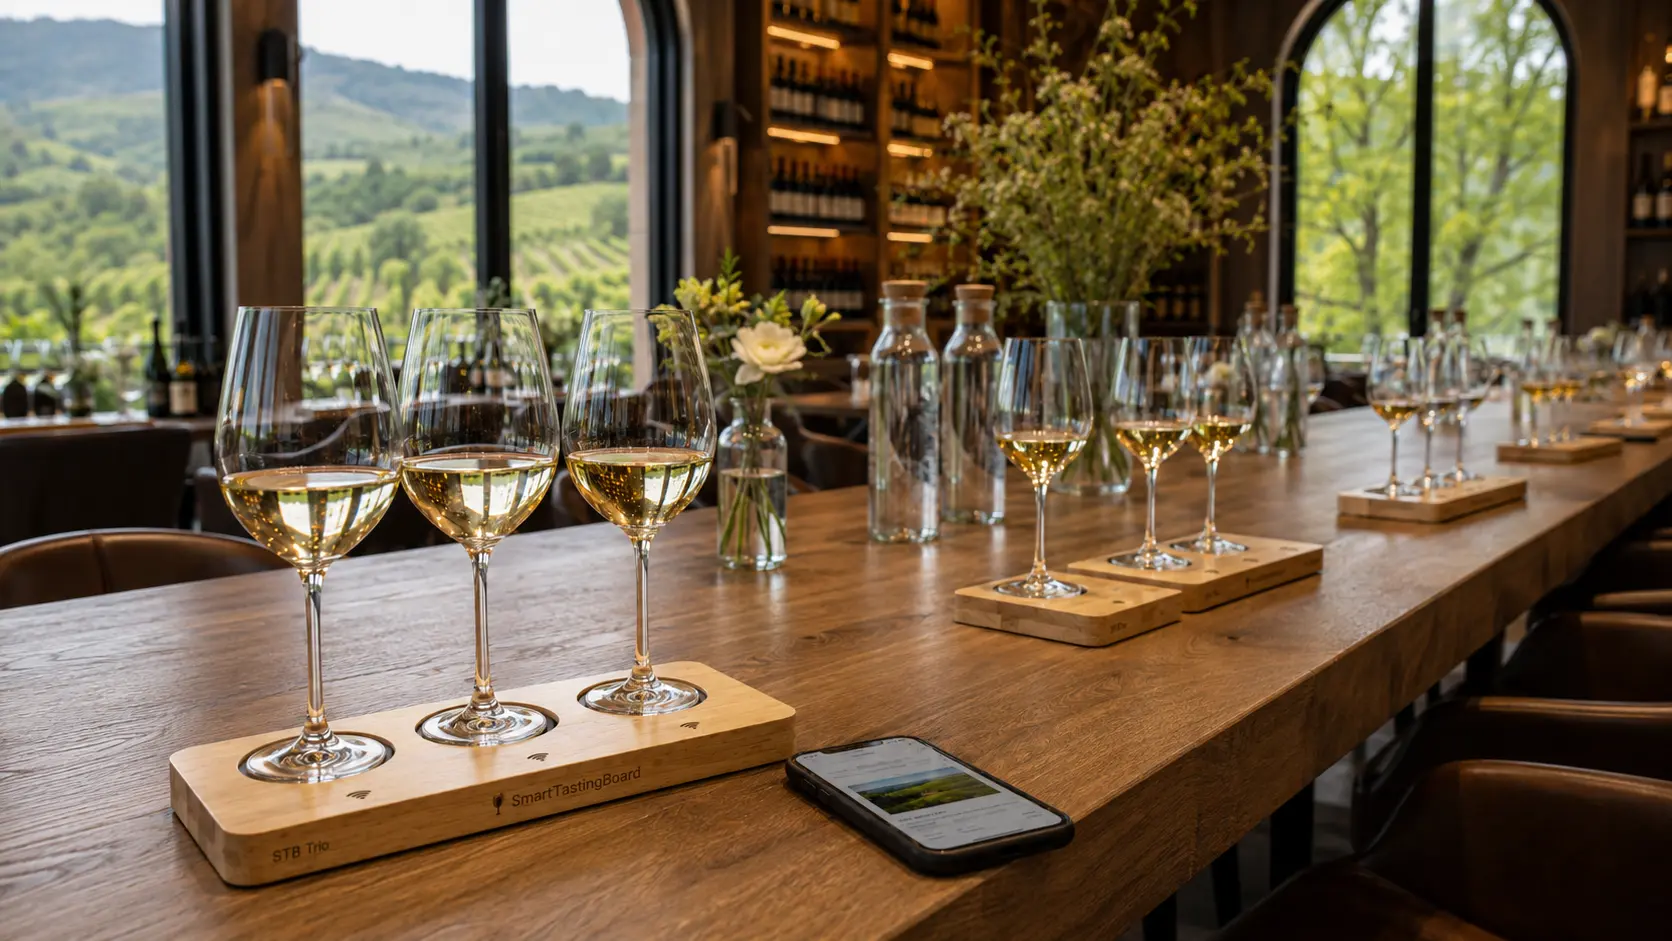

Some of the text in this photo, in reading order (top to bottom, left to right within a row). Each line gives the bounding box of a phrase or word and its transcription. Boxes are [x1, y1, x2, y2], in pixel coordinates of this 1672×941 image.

[511, 766, 641, 807] SmartTastingBoard
[272, 840, 330, 863] STB Trio
